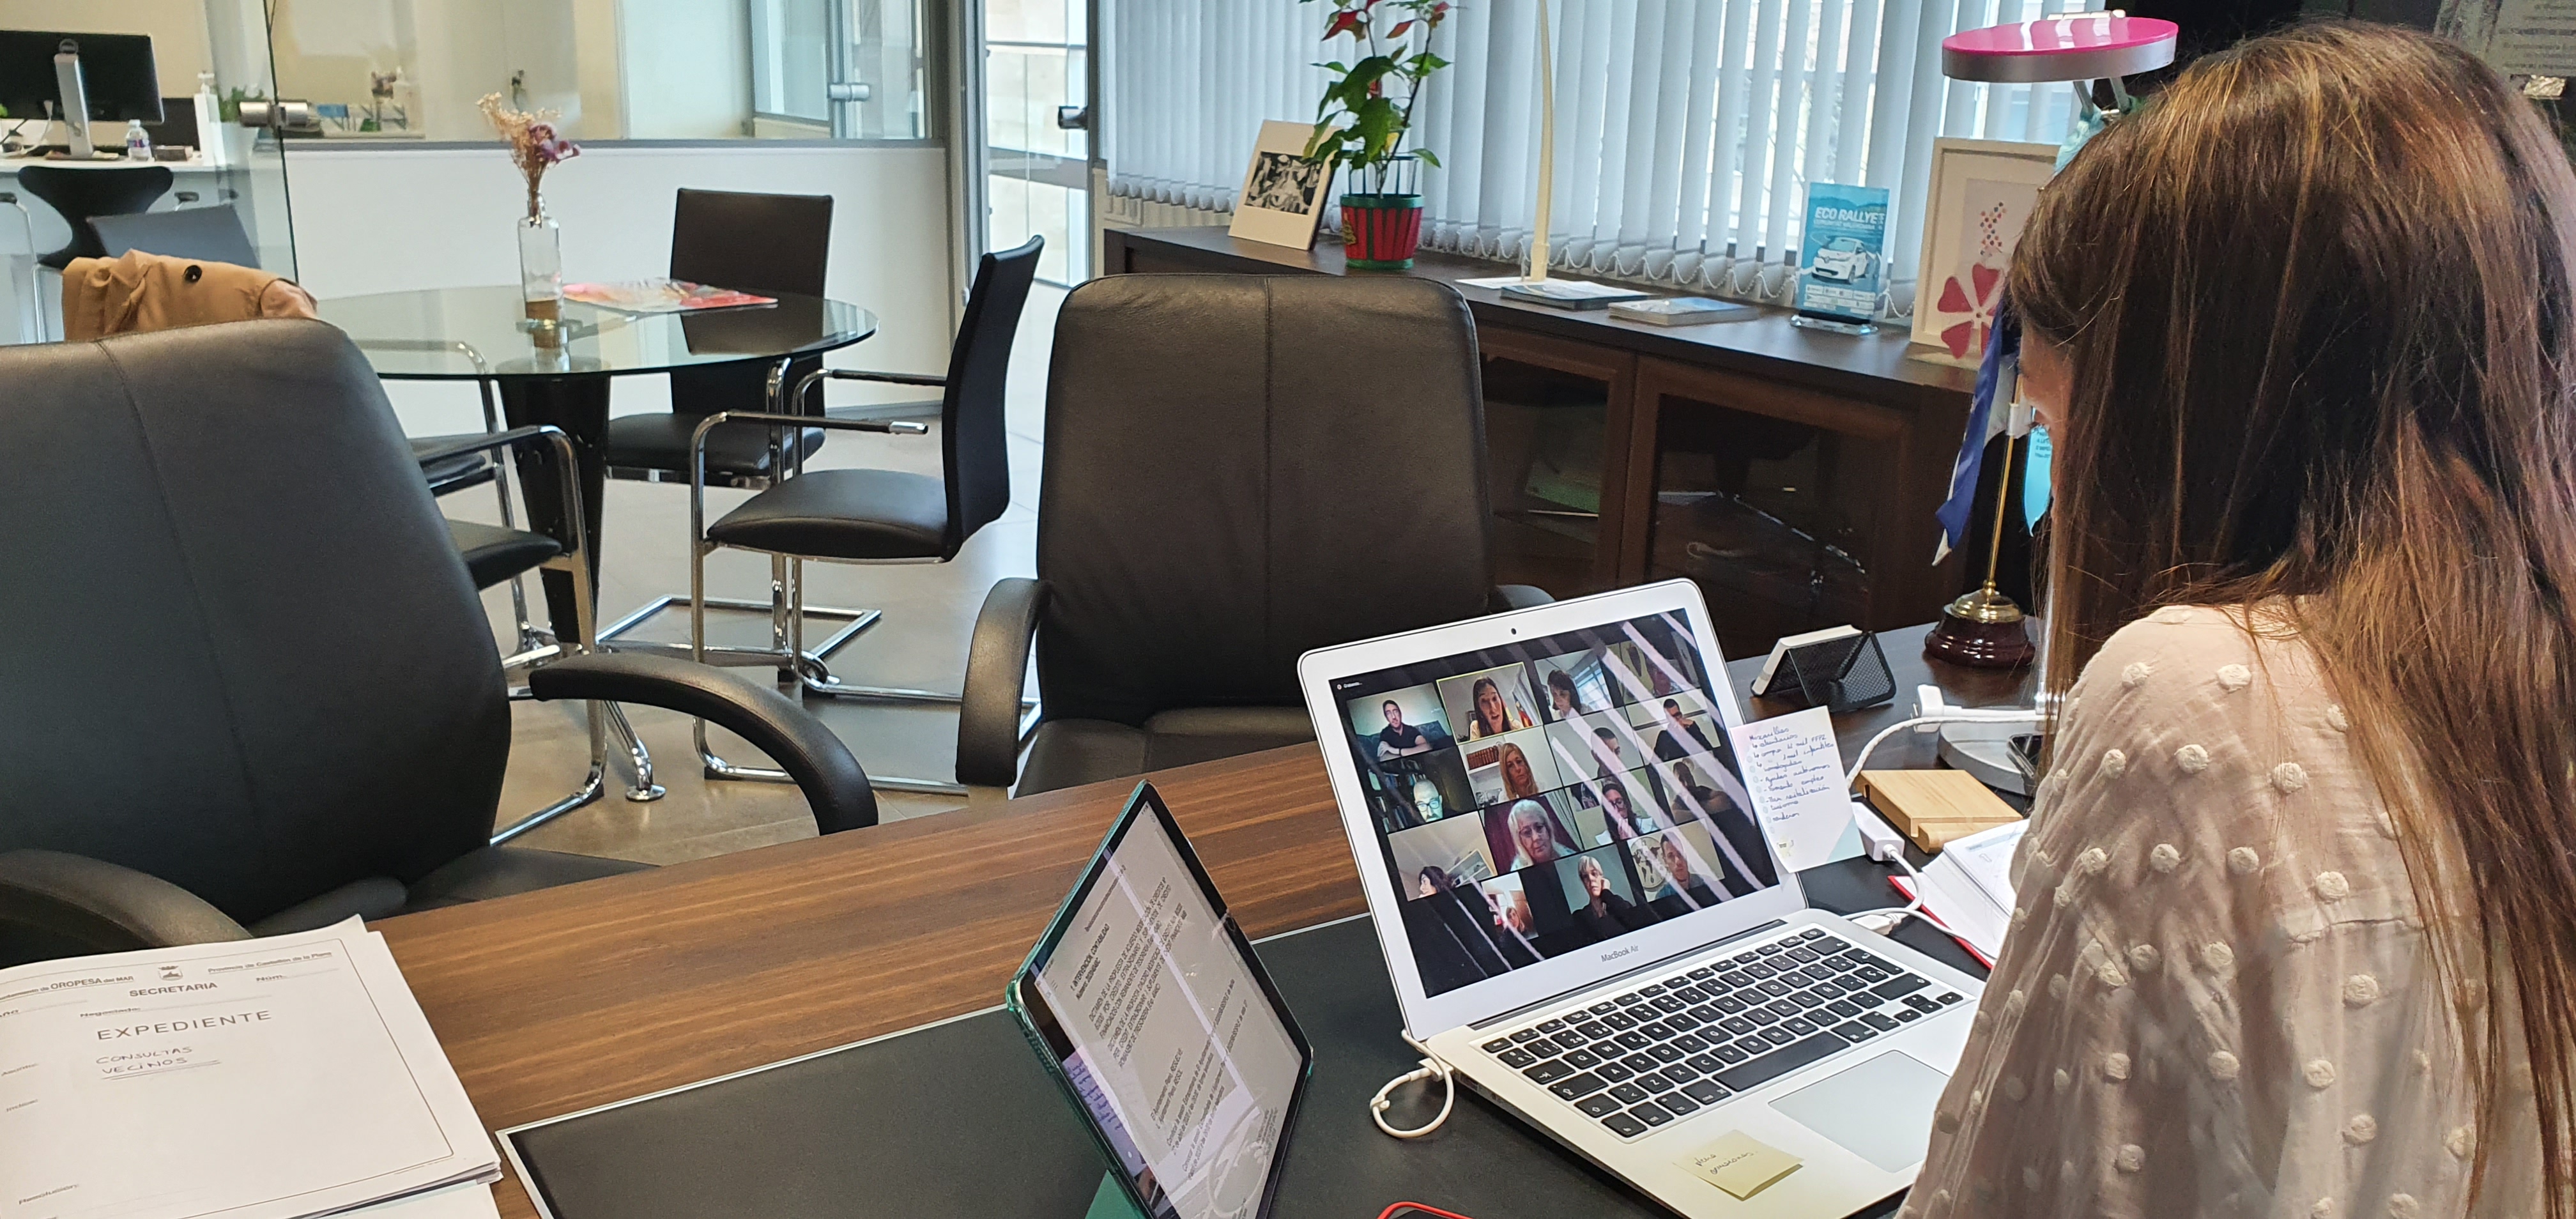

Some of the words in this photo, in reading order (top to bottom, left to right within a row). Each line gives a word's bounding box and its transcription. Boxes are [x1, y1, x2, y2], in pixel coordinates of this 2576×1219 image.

[1815, 206, 1837, 220] ECO
[1838, 209, 1878, 225] RALLYE
[1601, 947, 1630, 962] MacBook
[1630, 944, 1639, 953] Air
[50, 977, 102, 990] OROPESA
[129, 982, 218, 997] SECRETARIA
[96, 1010, 272, 1040] EXPEDIENTE
[96, 1046, 193, 1064] CONSULTAS
